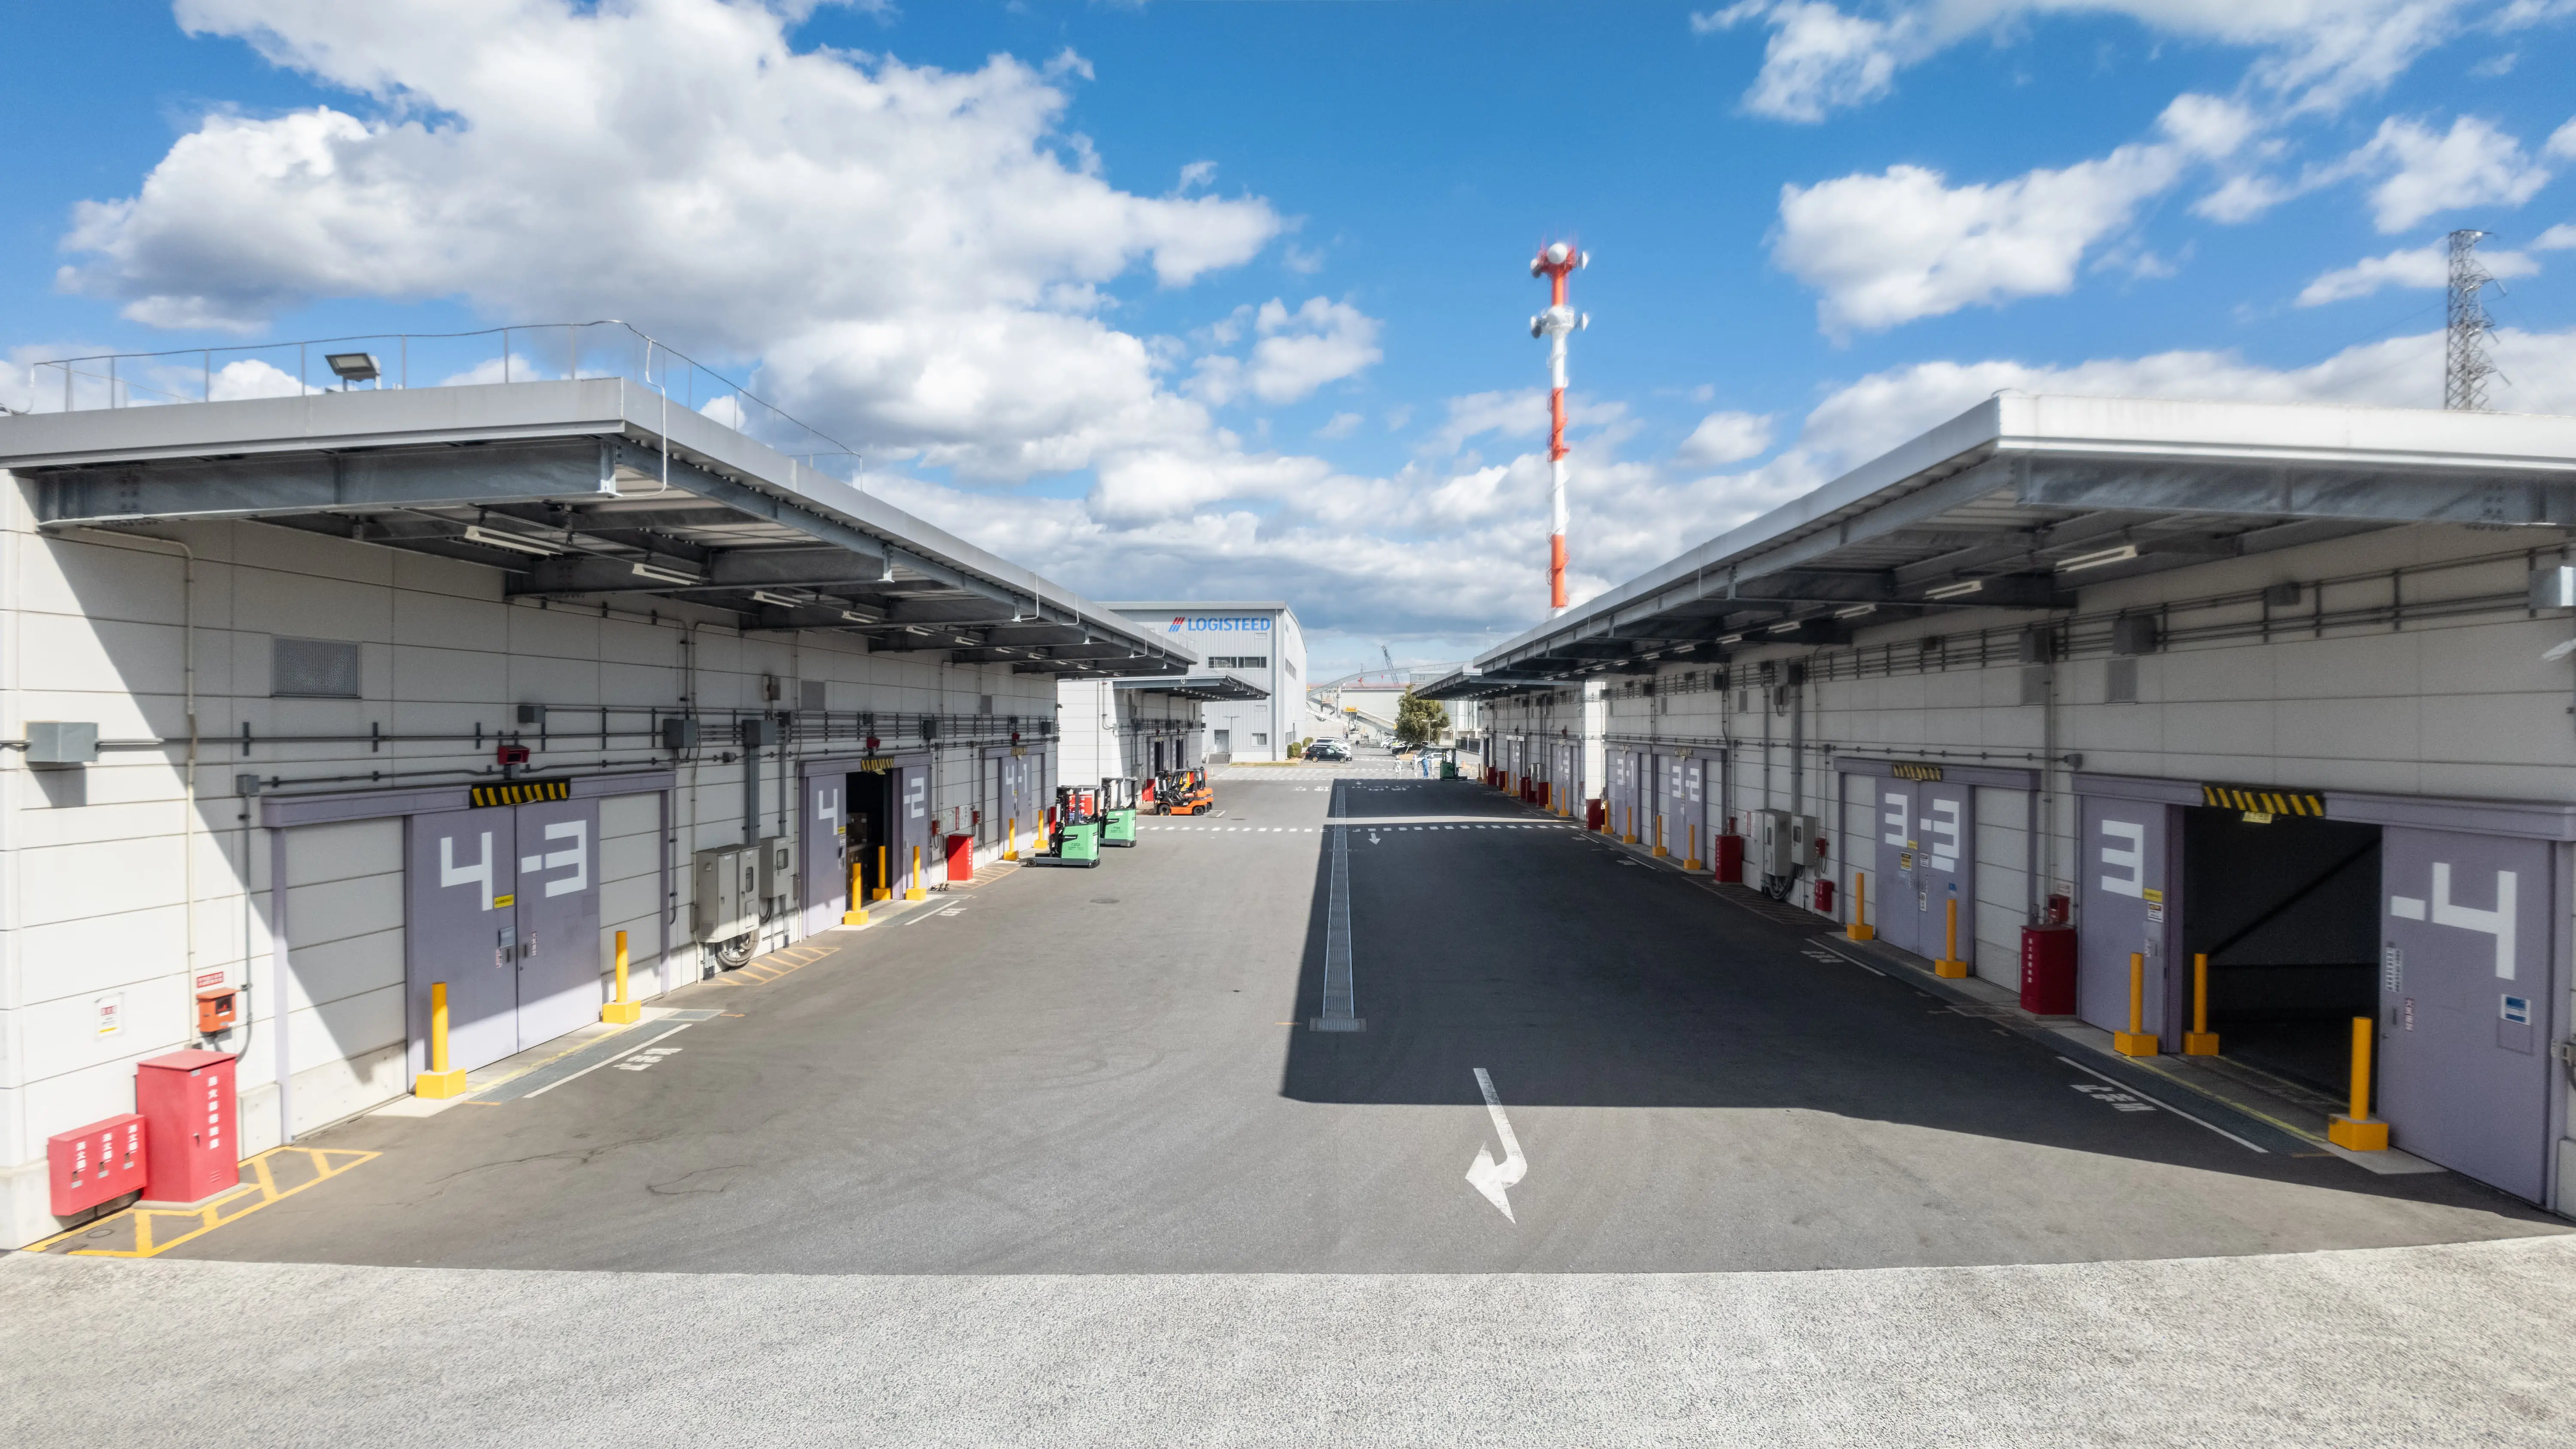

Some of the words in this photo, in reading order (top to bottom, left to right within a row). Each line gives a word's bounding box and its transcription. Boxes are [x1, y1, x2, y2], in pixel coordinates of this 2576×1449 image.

[1188, 618, 1270, 631] LOGISTEED
[1005, 763, 1027, 796] 4-1
[1617, 758, 1634, 788] 3-1
[1673, 766, 1699, 802] 3-2
[1885, 793, 1960, 859] 3-3
[440, 819, 587, 911] 4-3
